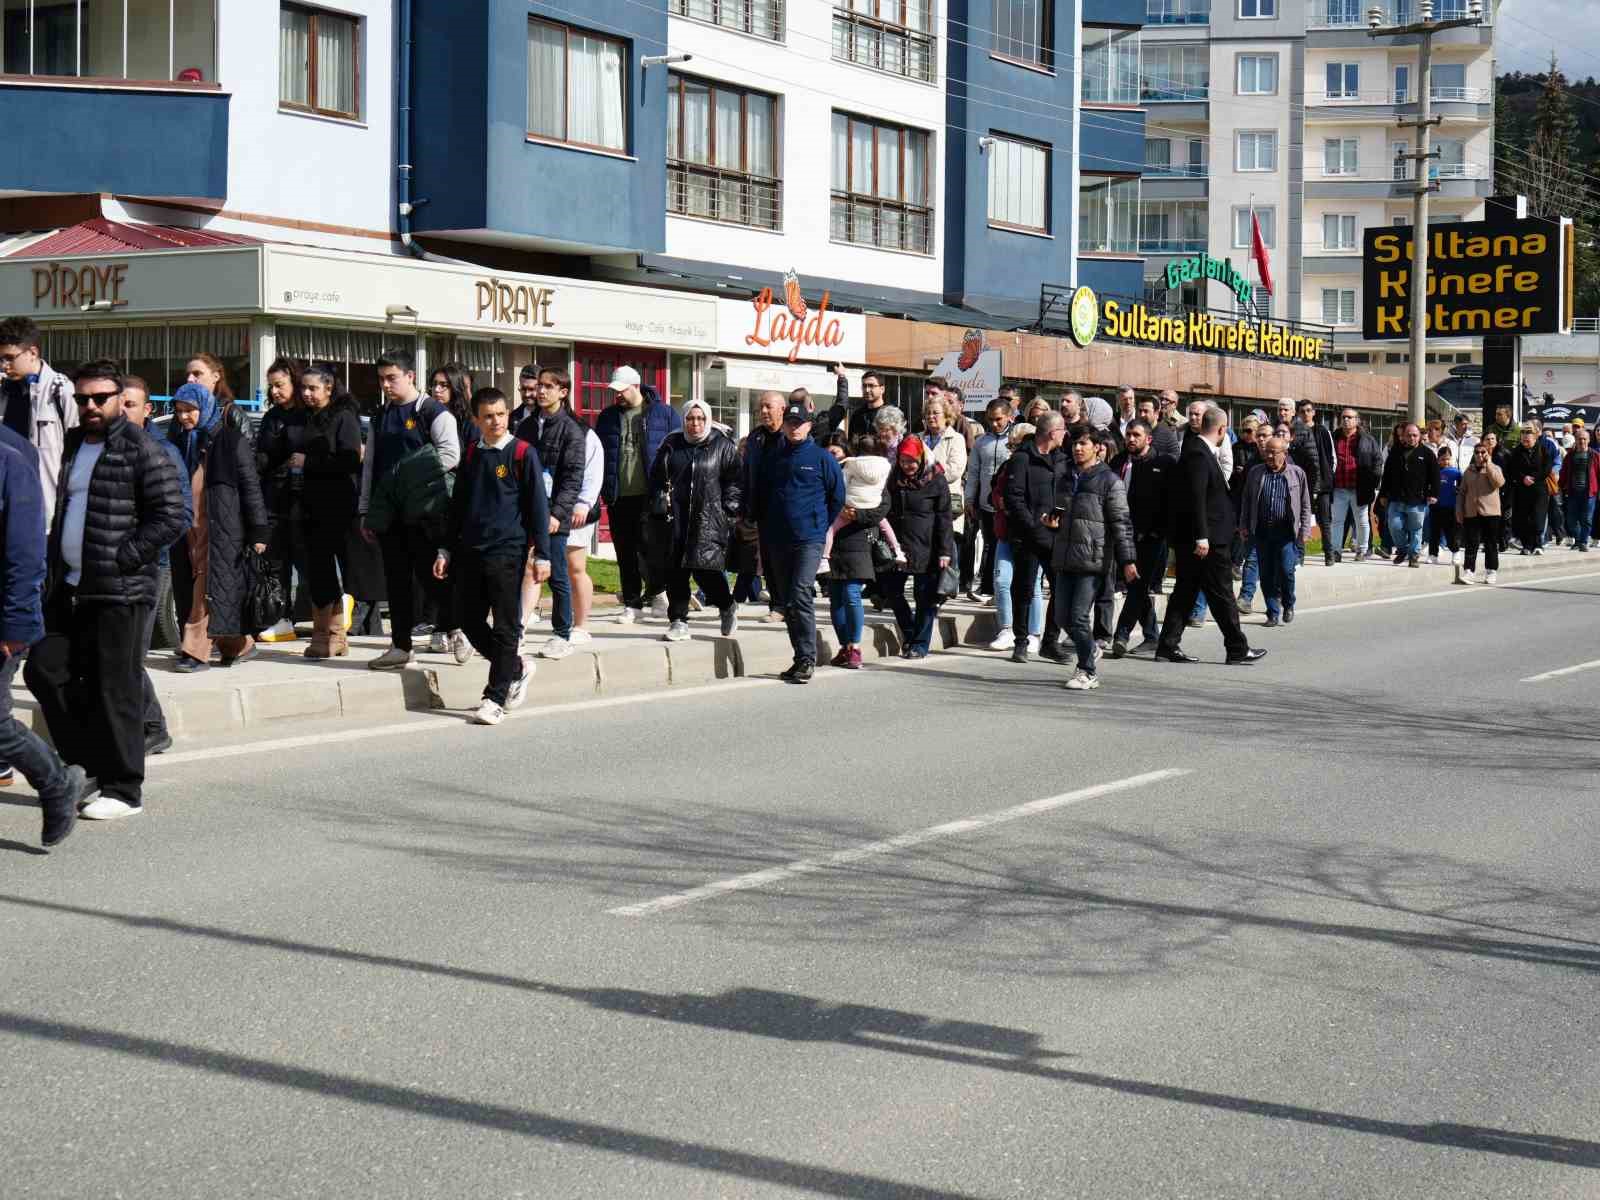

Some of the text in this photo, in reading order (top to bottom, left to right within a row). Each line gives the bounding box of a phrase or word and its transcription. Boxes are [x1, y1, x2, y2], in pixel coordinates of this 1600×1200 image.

[745, 287, 844, 362] Layda
[1104, 300, 1186, 344] Sultana
[1189, 312, 1258, 352] Künefe
[1260, 321, 1324, 361] Katmer
